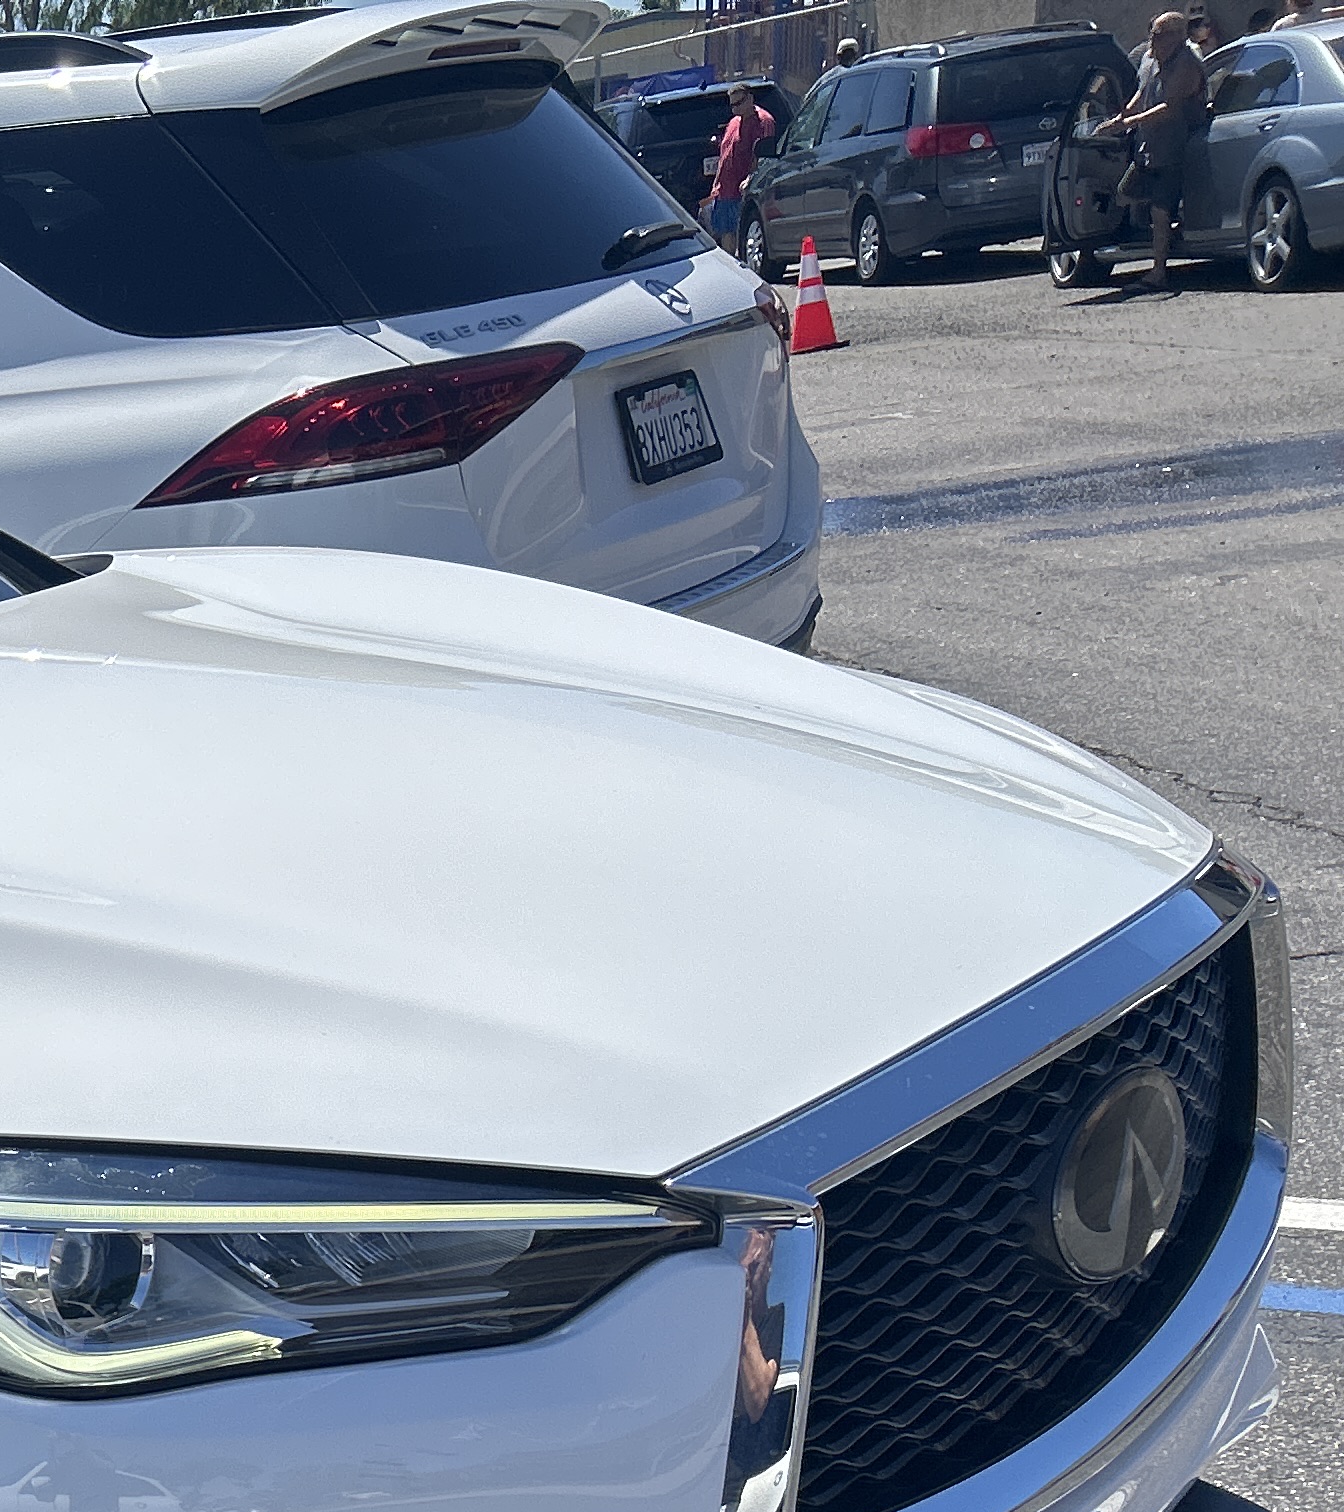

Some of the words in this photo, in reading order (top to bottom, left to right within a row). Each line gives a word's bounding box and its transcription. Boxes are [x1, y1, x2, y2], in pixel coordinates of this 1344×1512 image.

[421, 324, 475, 347] GLE
[478, 314, 526, 333] 450
[636, 406, 704, 465] 8XHU353
